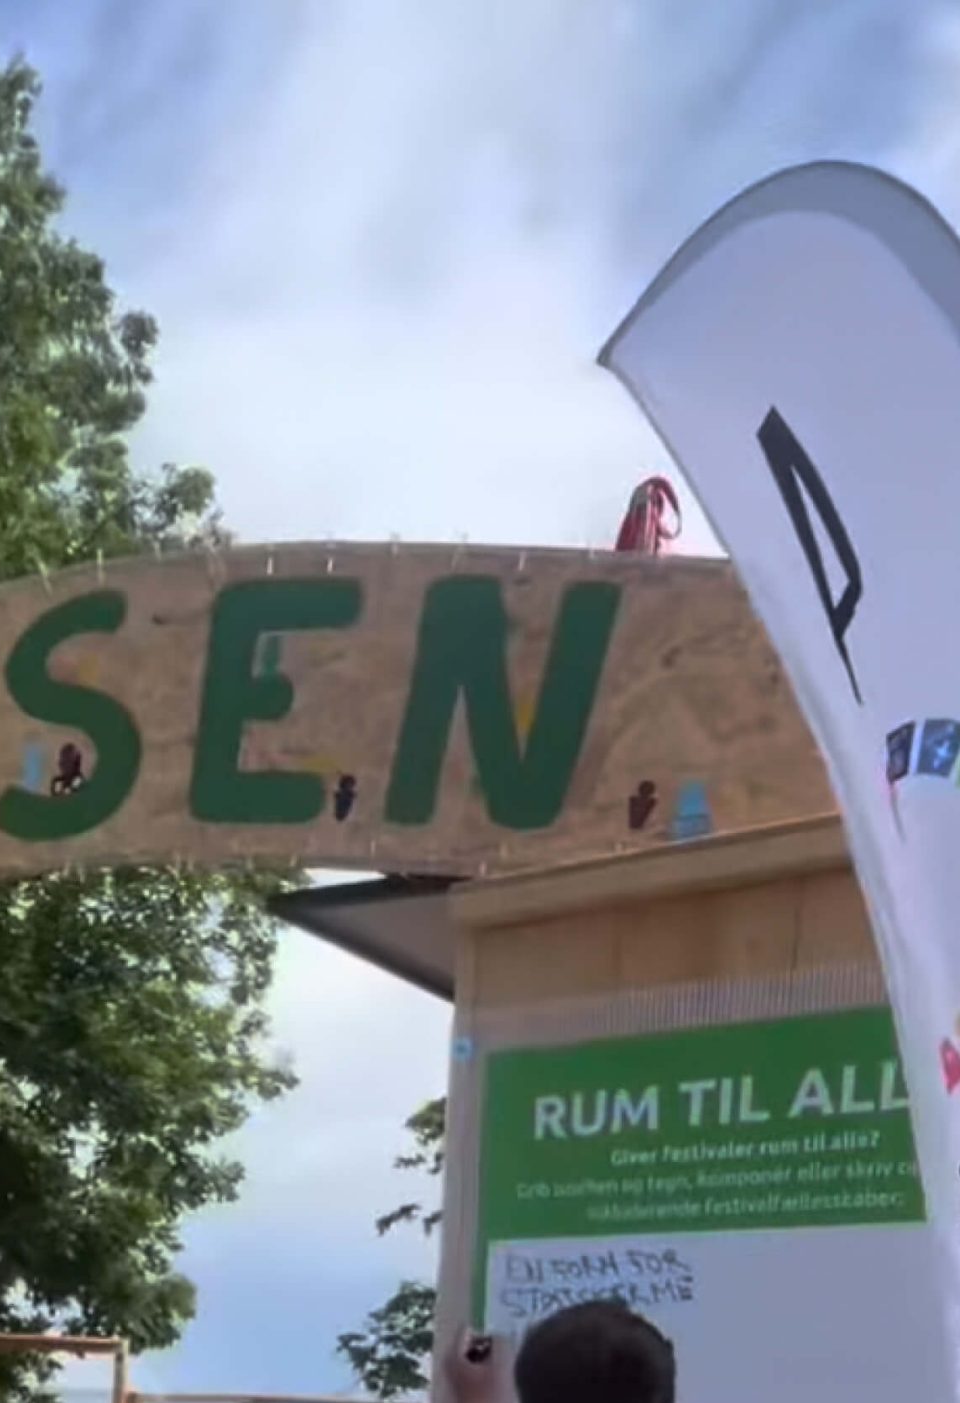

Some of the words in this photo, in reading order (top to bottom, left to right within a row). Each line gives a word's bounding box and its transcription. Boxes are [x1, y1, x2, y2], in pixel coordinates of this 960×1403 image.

[534, 1084, 660, 1141] RUM
[677, 1074, 771, 1128] TIL
[786, 1058, 912, 1119] ALL
[662, 1142, 754, 1162] festivaler
[760, 1140, 799, 1156] rum
[804, 1133, 826, 1153] til
[829, 1130, 881, 1151] alle?
